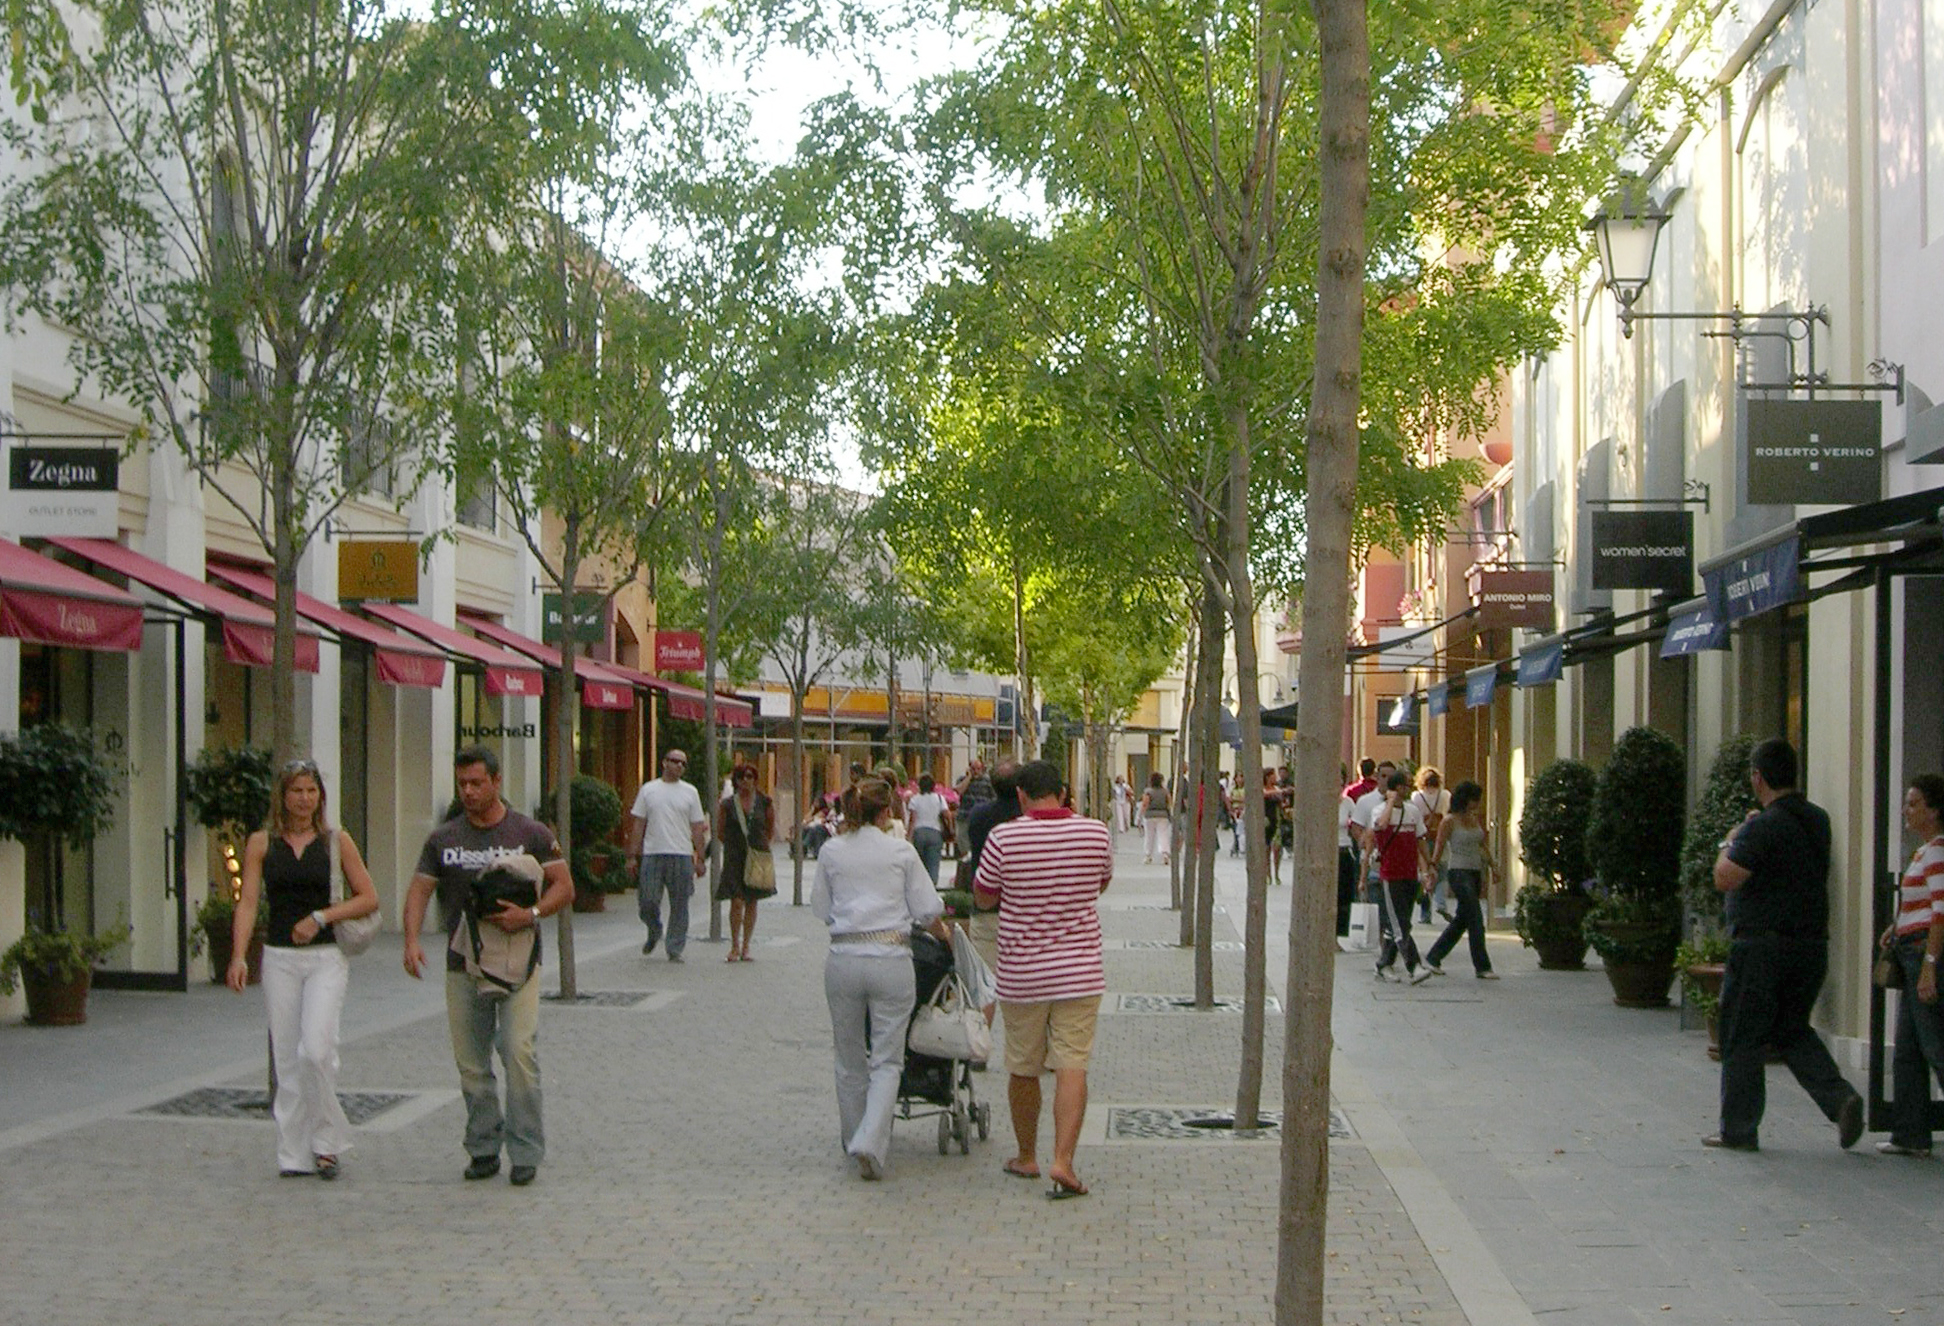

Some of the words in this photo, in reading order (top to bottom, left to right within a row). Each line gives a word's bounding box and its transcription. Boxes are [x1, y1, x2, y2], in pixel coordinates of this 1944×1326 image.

[1755, 447, 1819, 457] ROBERTO
[1823, 447, 1875, 457] VERINO
[29, 458, 97, 487] Zegna
[1600, 544, 1687, 557] women'secret
[1483, 593, 1526, 602] ANTONIO
[1527, 593, 1552, 602] MIRO
[549, 611, 598, 624] Baur
[660, 645, 701, 660] Triumph
